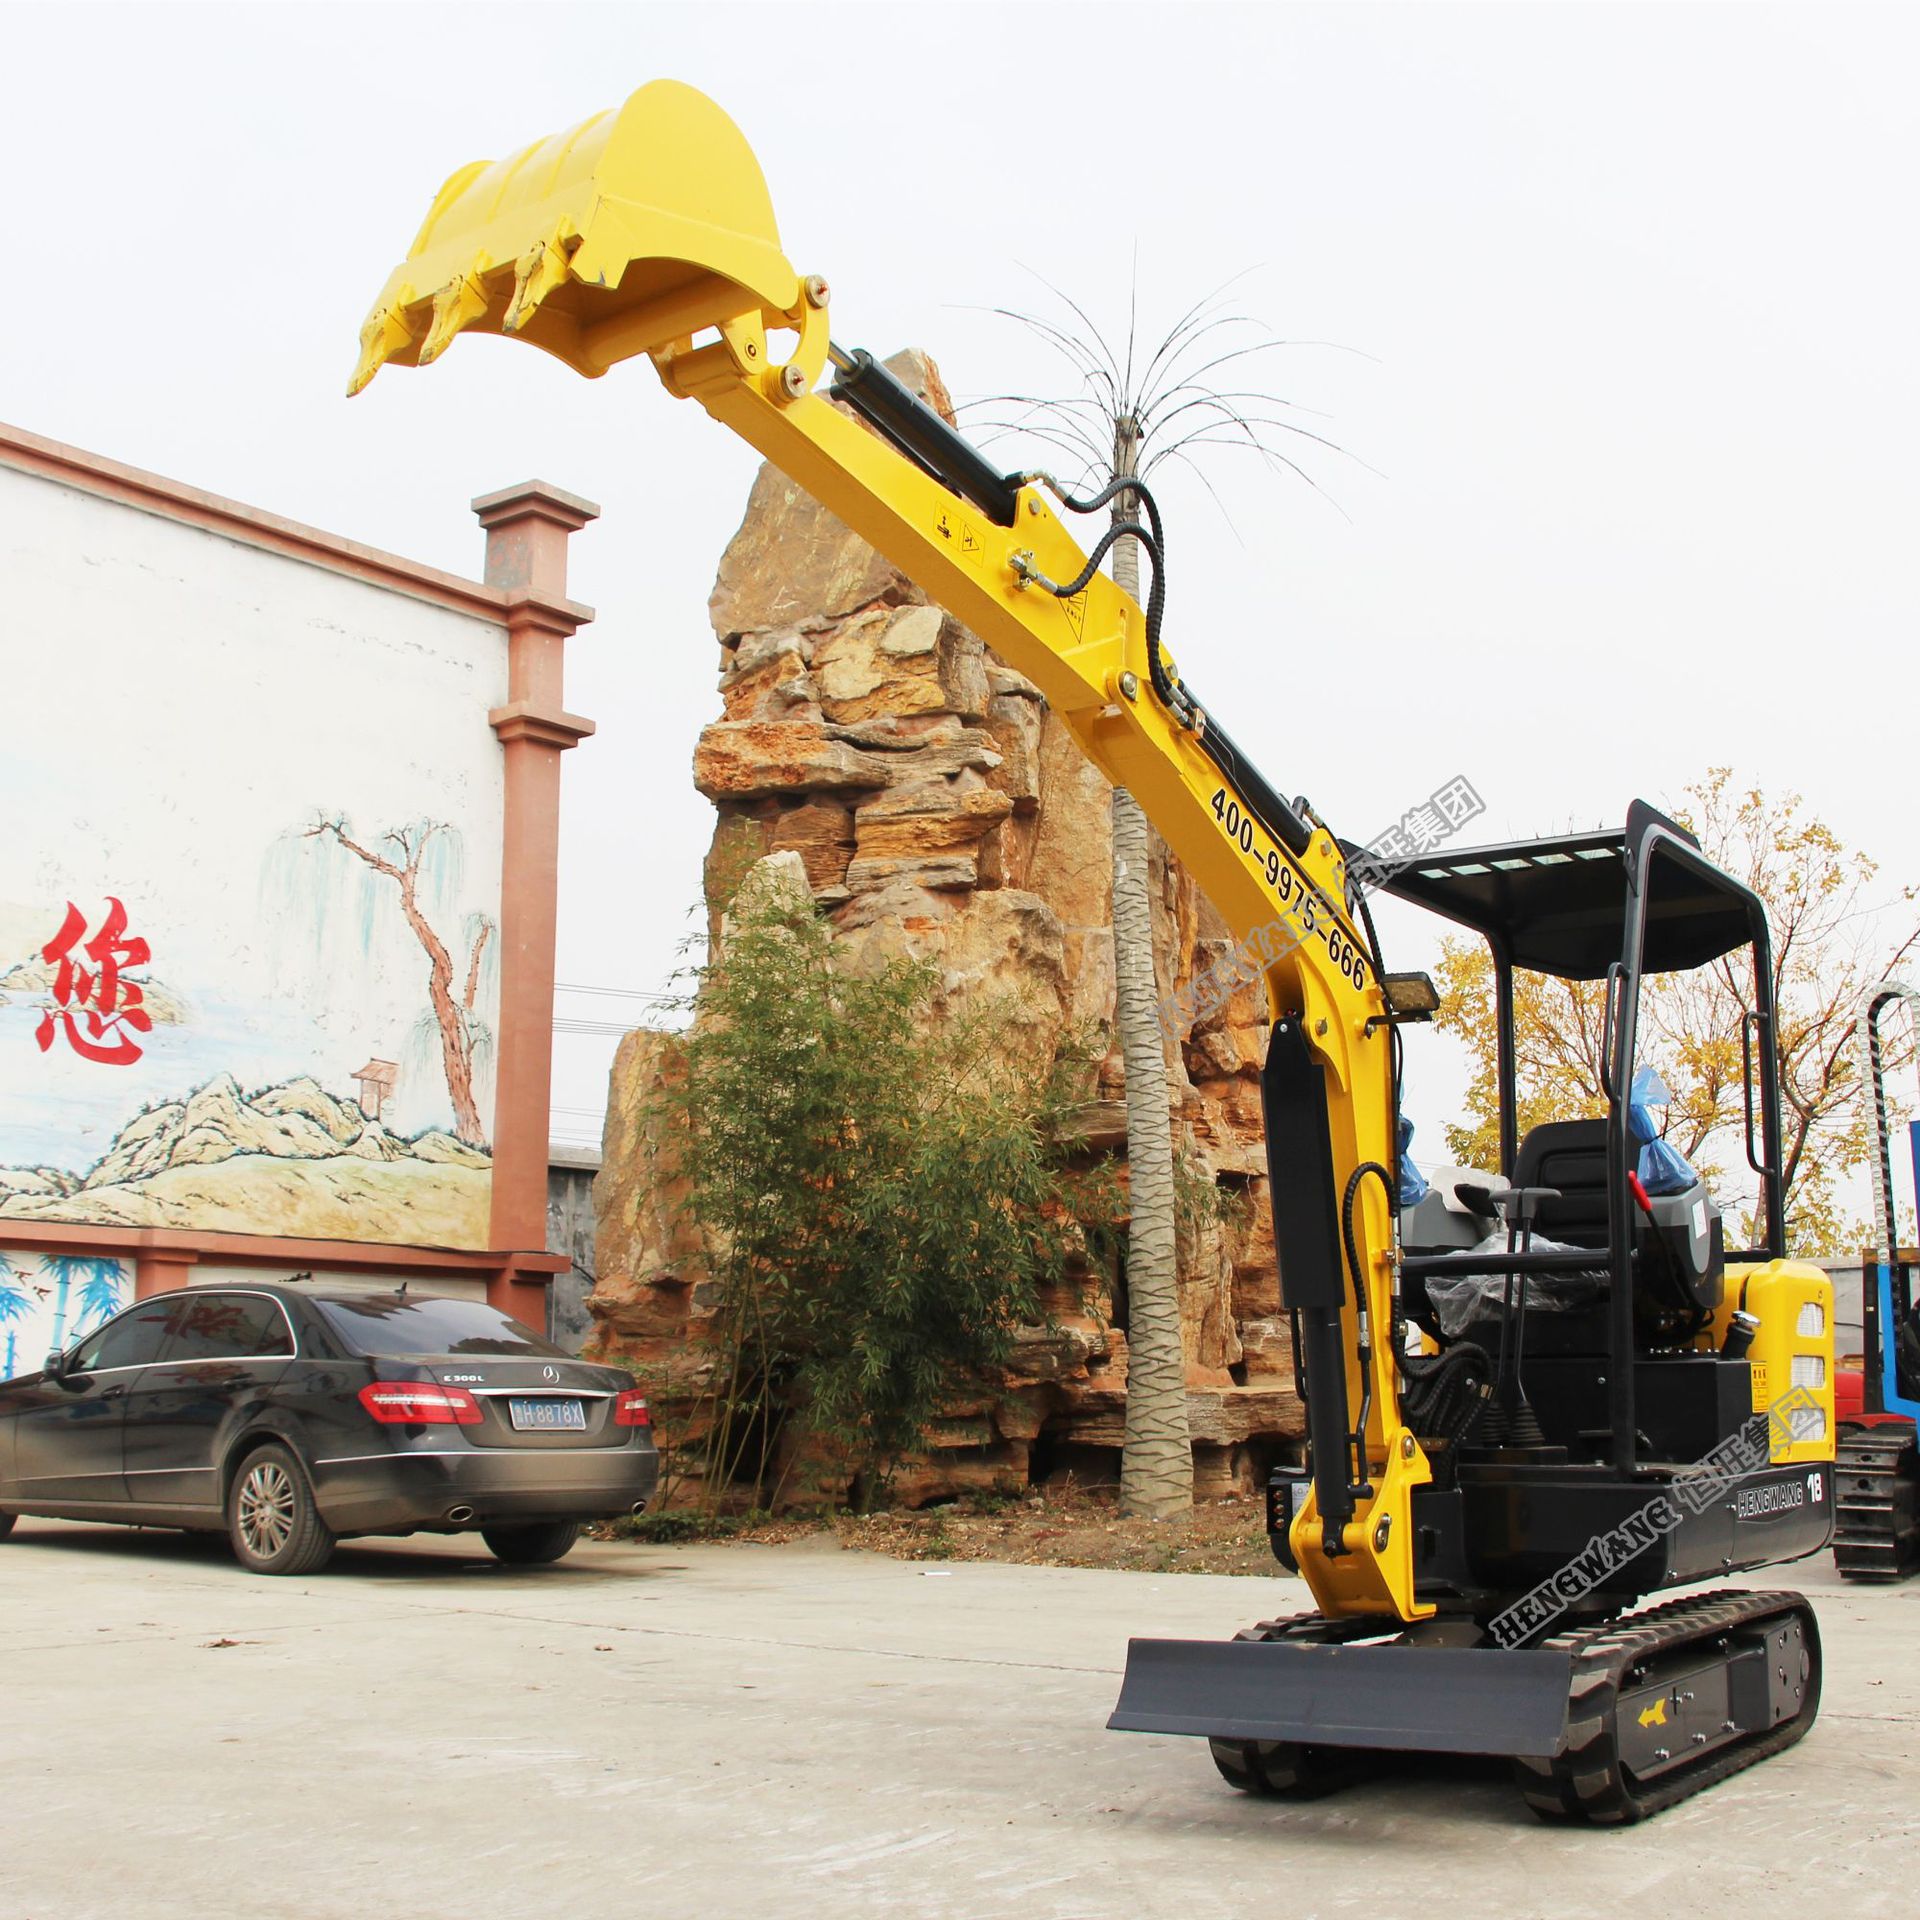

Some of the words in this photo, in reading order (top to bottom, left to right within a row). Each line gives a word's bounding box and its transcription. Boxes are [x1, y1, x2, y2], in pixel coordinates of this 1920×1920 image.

[1210, 787, 1367, 991] 400-9975-666
[35, 896, 152, 1066] 您
[1736, 1482, 1804, 1518] HENGWANG
[1807, 1472, 1823, 1503] 18
